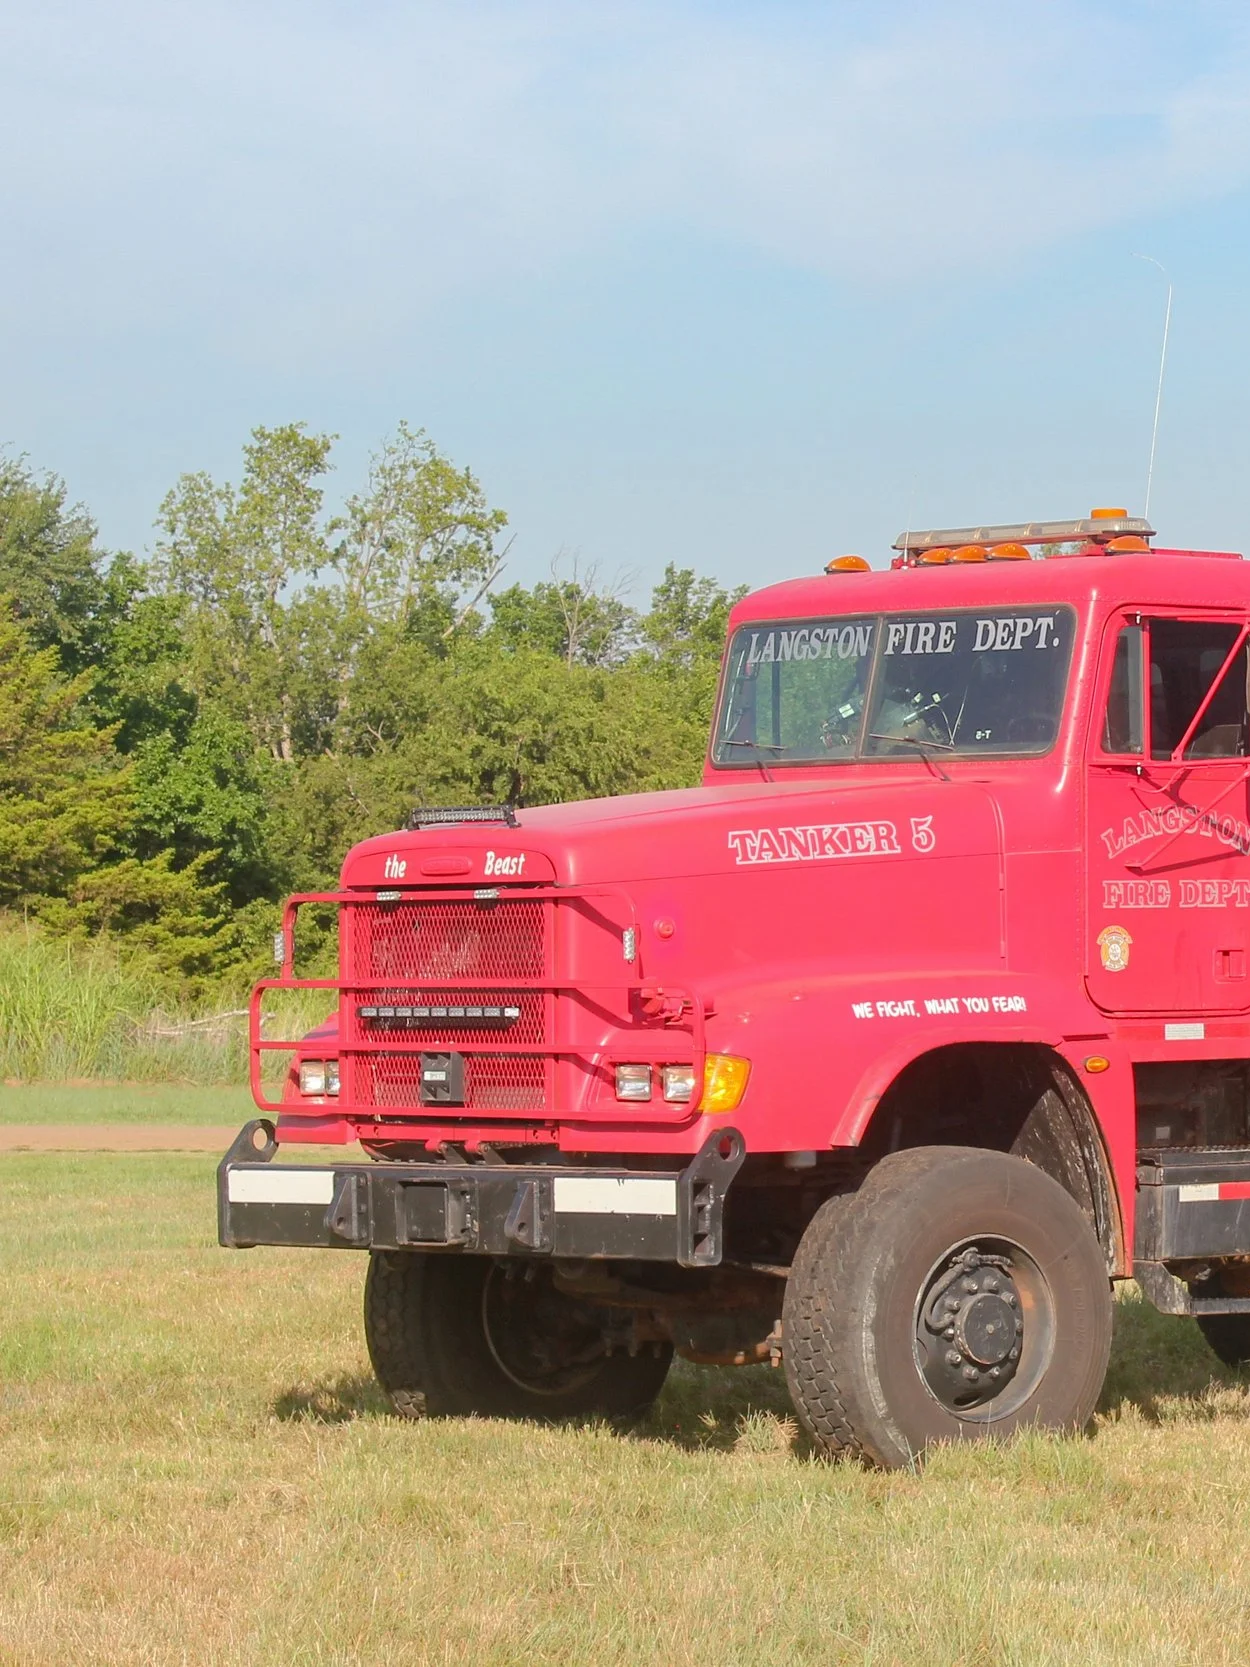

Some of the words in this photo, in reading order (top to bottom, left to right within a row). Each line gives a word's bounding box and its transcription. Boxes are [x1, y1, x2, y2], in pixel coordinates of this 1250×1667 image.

[747, 626, 873, 663] LANGSTON
[884, 621, 957, 656] FIRE
[972, 616, 1060, 652] DEPT.
[728, 820, 901, 865] TANKER
[910, 815, 935, 853] 5
[384, 854, 407, 879] the
[484, 851, 526, 876] Beast
[1102, 880, 1171, 909] FIRE
[852, 1002, 874, 1019] WE
[876, 1000, 921, 1018] FIGHT,
[924, 998, 960, 1015] WHAT
[961, 997, 989, 1013] YOU
[991, 996, 1027, 1013] FEAR!
